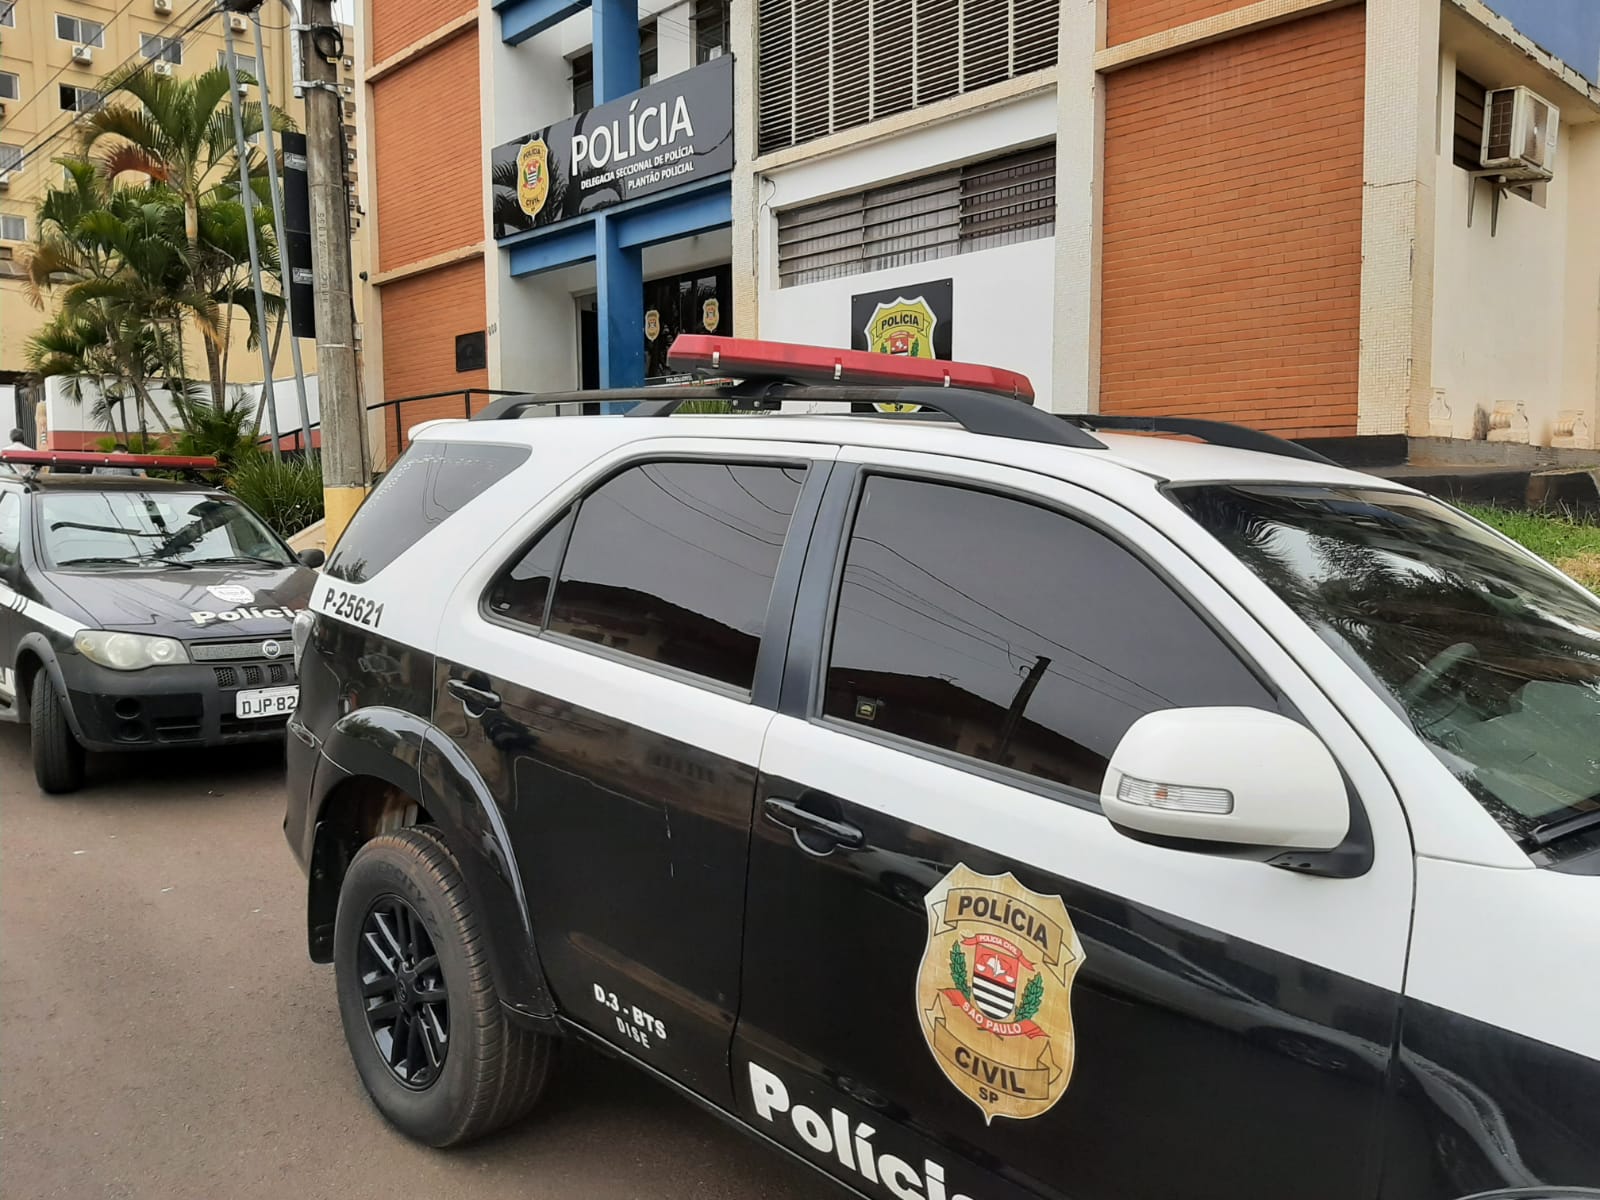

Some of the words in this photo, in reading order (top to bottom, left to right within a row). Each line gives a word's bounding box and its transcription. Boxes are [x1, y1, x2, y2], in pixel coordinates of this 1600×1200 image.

[571, 95, 694, 177] POLÍCIA
[580, 172, 615, 190] DELEGACIA
[615, 159, 654, 179] SECCIONAL
[653, 155, 664, 167] DE
[664, 144, 694, 162] POLÍCIA
[628, 171, 660, 190] PLANTÃO
[661, 161, 694, 179] POLICIAL
[958, 895, 1050, 951] POLÍCIA
[615, 1016, 651, 1049] DISE
[632, 1005, 667, 1040] BTS
[985, 1019, 1021, 1034] PAULO
[954, 1046, 1027, 1095] CIVIL
[978, 1086, 999, 1104] SP
[748, 1061, 974, 1200] Políci
